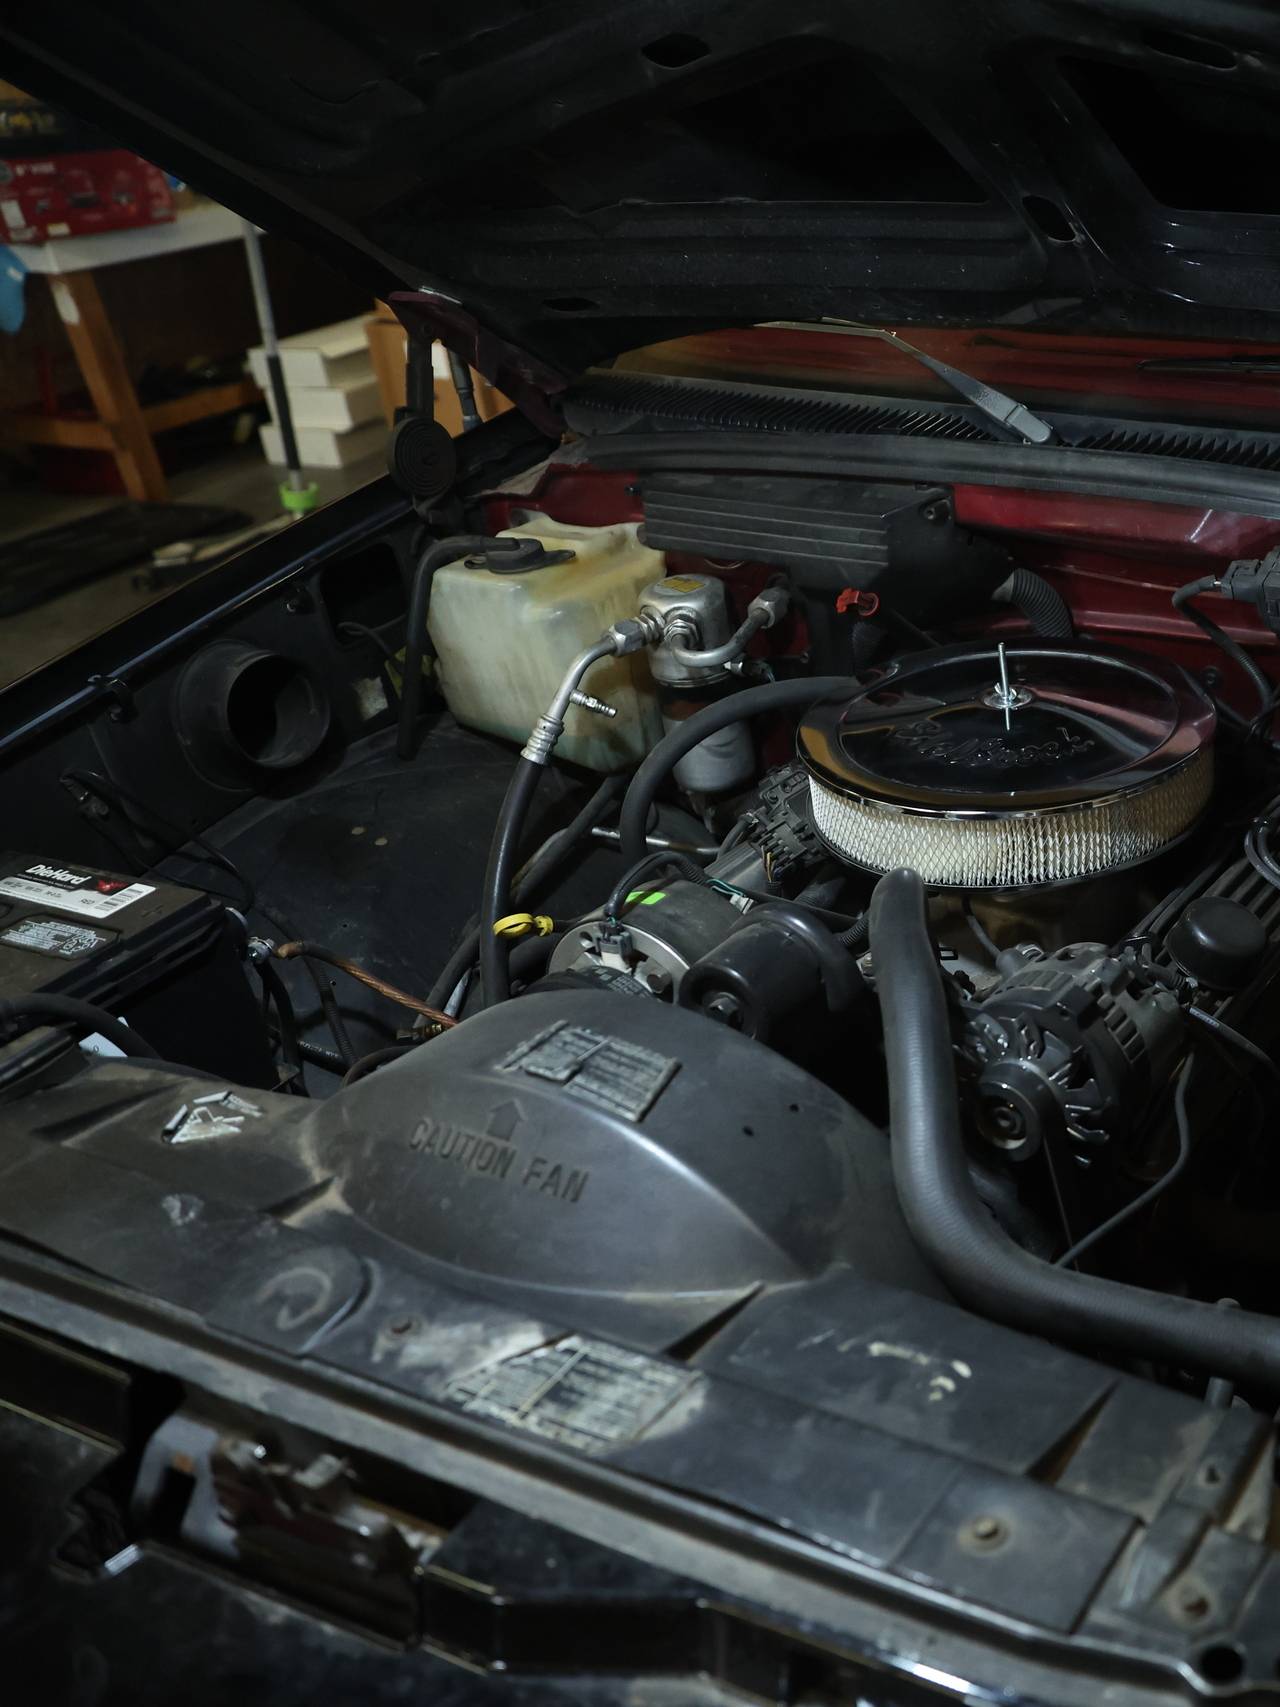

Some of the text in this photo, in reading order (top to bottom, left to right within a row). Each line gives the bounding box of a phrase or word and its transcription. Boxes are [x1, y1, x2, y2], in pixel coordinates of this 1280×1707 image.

[25, 864, 92, 885] DieHard
[410, 1117, 589, 1203] CAUTION FAN
